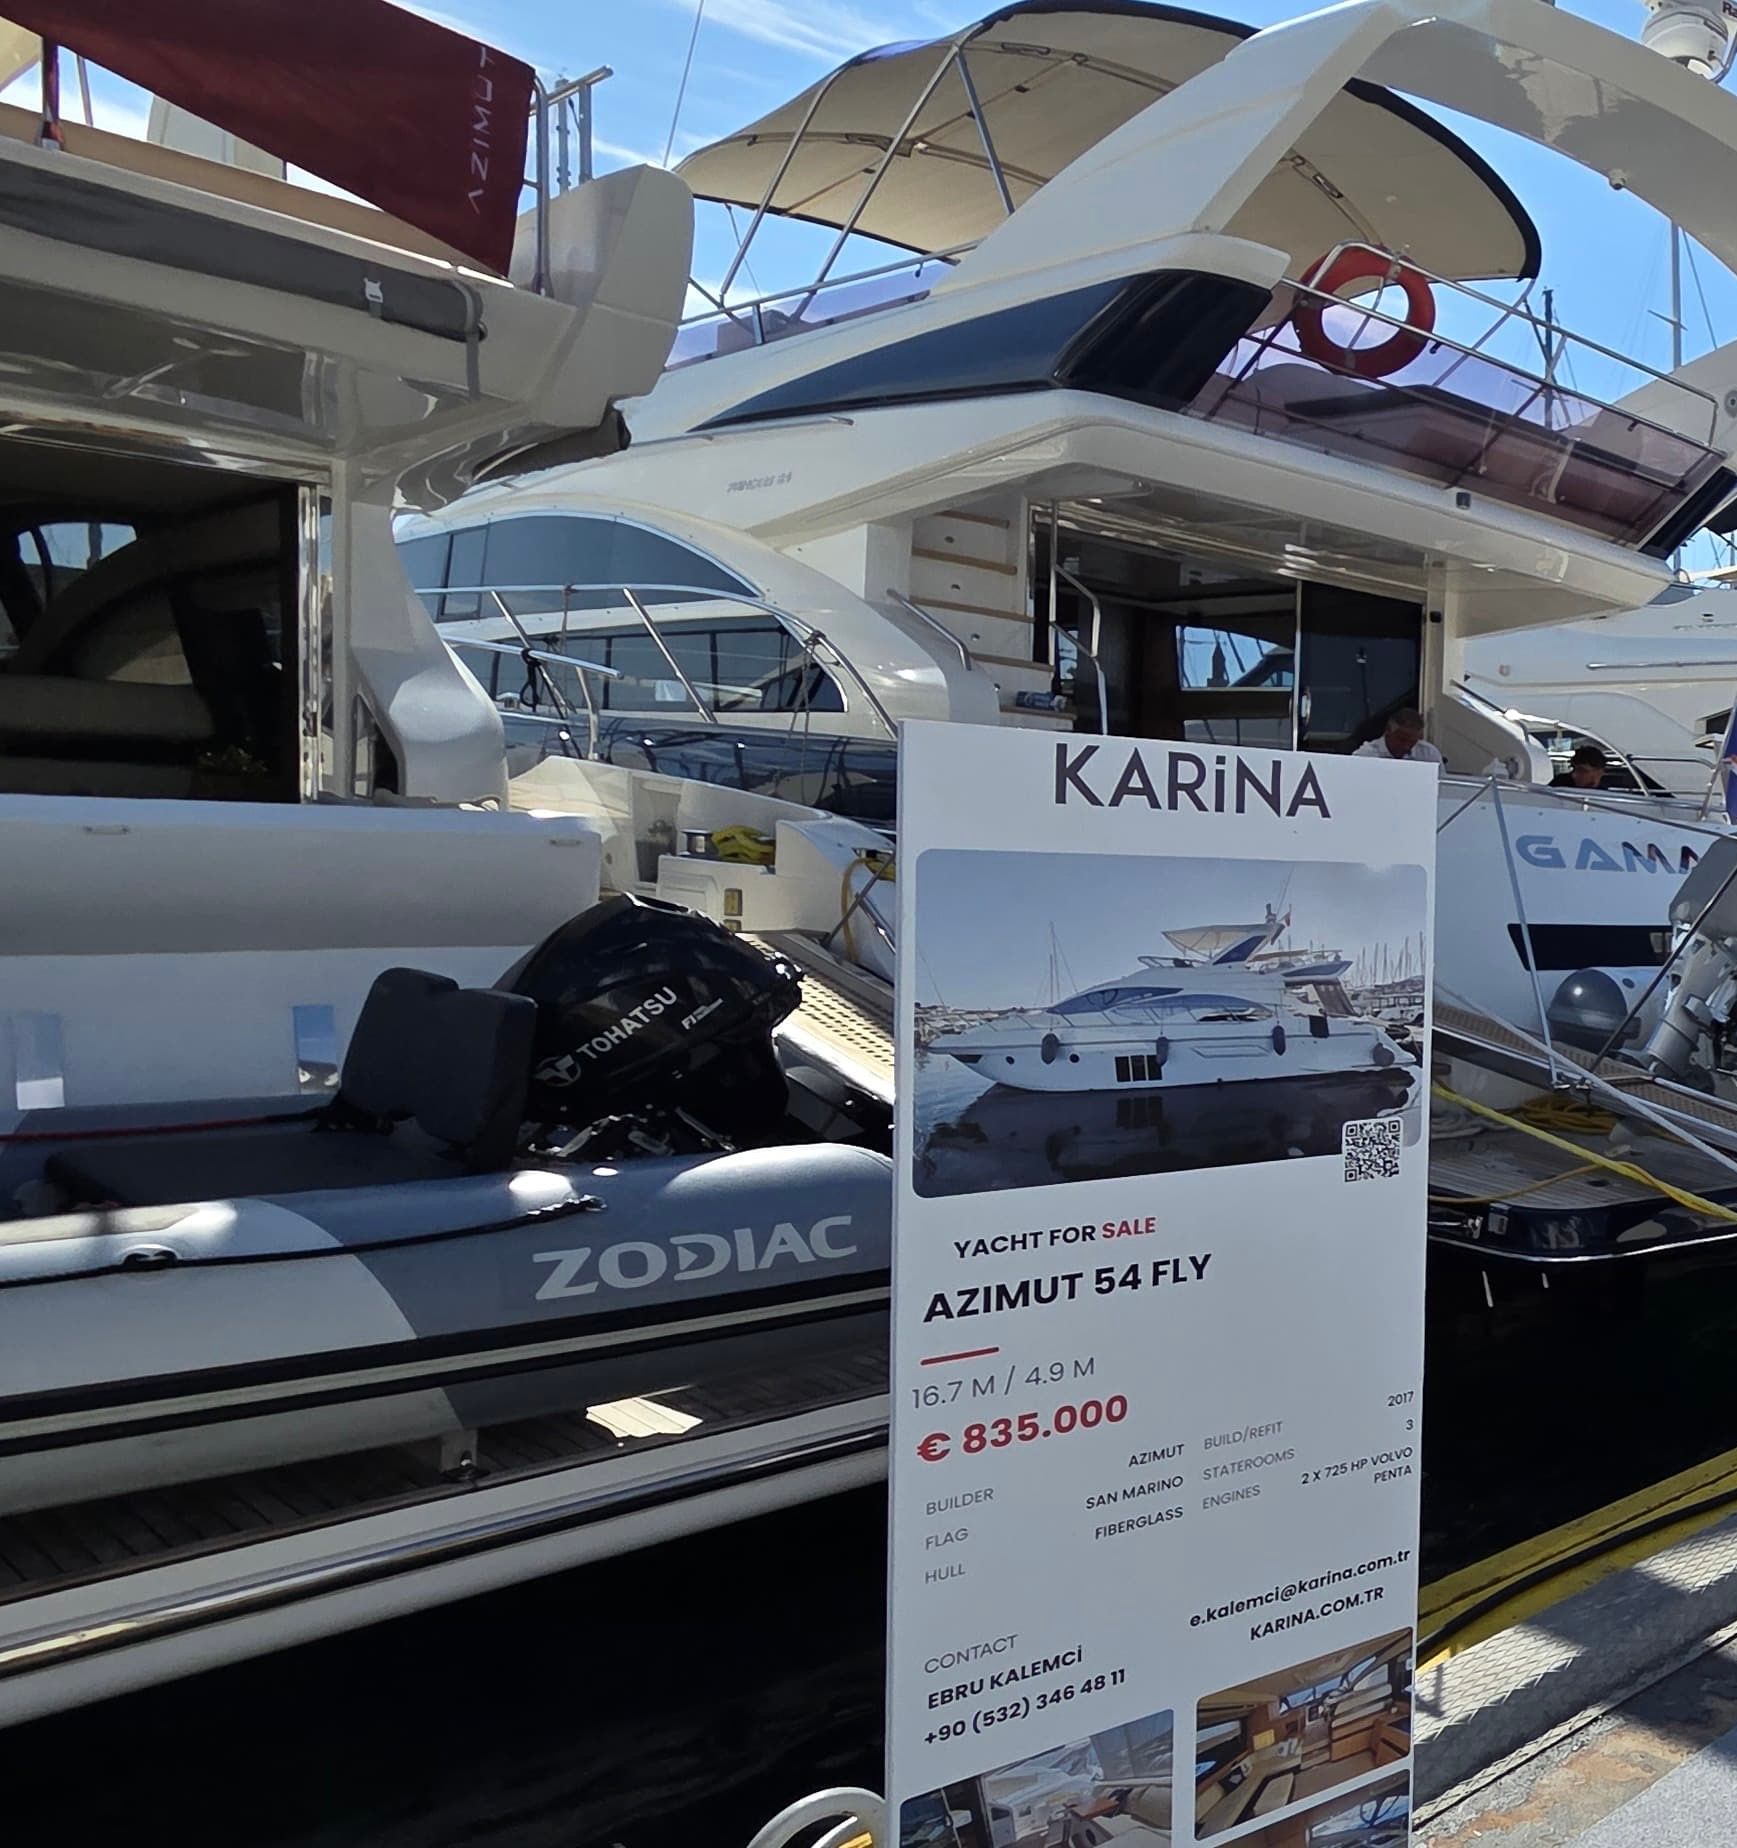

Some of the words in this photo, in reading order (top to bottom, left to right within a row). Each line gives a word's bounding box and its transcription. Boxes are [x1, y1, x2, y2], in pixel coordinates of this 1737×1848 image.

[468, 46, 496, 215] AZIMUT
[576, 986, 678, 1059] TOHATSU
[532, 1215, 857, 1300] ZODIAC
[954, 1230, 1043, 1259] YACHT
[1049, 1224, 1096, 1247] FOR
[1102, 1216, 1157, 1239] SALE
[923, 1272, 1083, 1323] AZIMUT
[1095, 1263, 1142, 1295] 54
[1152, 1253, 1212, 1287] FLY
[912, 1380, 963, 1409] 16.7
[972, 1375, 995, 1398] M
[1003, 1364, 1016, 1396] /
[1024, 1361, 1064, 1386] 4.9
[1073, 1356, 1095, 1379] M
[916, 1432, 951, 1462] €
[962, 1394, 1128, 1454] 835.000
[1202, 1448, 1295, 1481] STATEROOMS
[1405, 1419, 1414, 1431] 3
[1203, 1420, 1283, 1450] BUILD/REFIT
[1387, 1391, 1414, 1408] 2017
[925, 1487, 995, 1516] BUILDER
[1128, 1443, 1185, 1468] AZIMUT
[1202, 1484, 1261, 1510] ENGINES
[1301, 1472, 1310, 1485] 2
[1325, 1462, 1348, 1479] 725
[1351, 1457, 1368, 1472] HP
[1371, 1446, 1413, 1466] VOLVO
[1374, 1464, 1412, 1484] PENTA
[924, 1563, 966, 1585] HULL
[1095, 1506, 1184, 1540] FIBERGLASS
[925, 1527, 969, 1550] FLAG
[1086, 1490, 1118, 1510] SAN
[1122, 1475, 1184, 1501] MARINO
[1189, 1550, 1411, 1627] e.kalemci@karina.com.tr
[1250, 1586, 1384, 1641] KARINA.COM.TR
[924, 1633, 1018, 1674] CONTACT
[928, 1678, 985, 1710] EBRU
[990, 1644, 1083, 1690] KALEMCİ
[924, 1720, 967, 1745] +90
[972, 1696, 1030, 1734] (532)
[1036, 1685, 1075, 1710] 346
[1080, 1675, 1106, 1694] 48
[1110, 1668, 1126, 1686] 11
